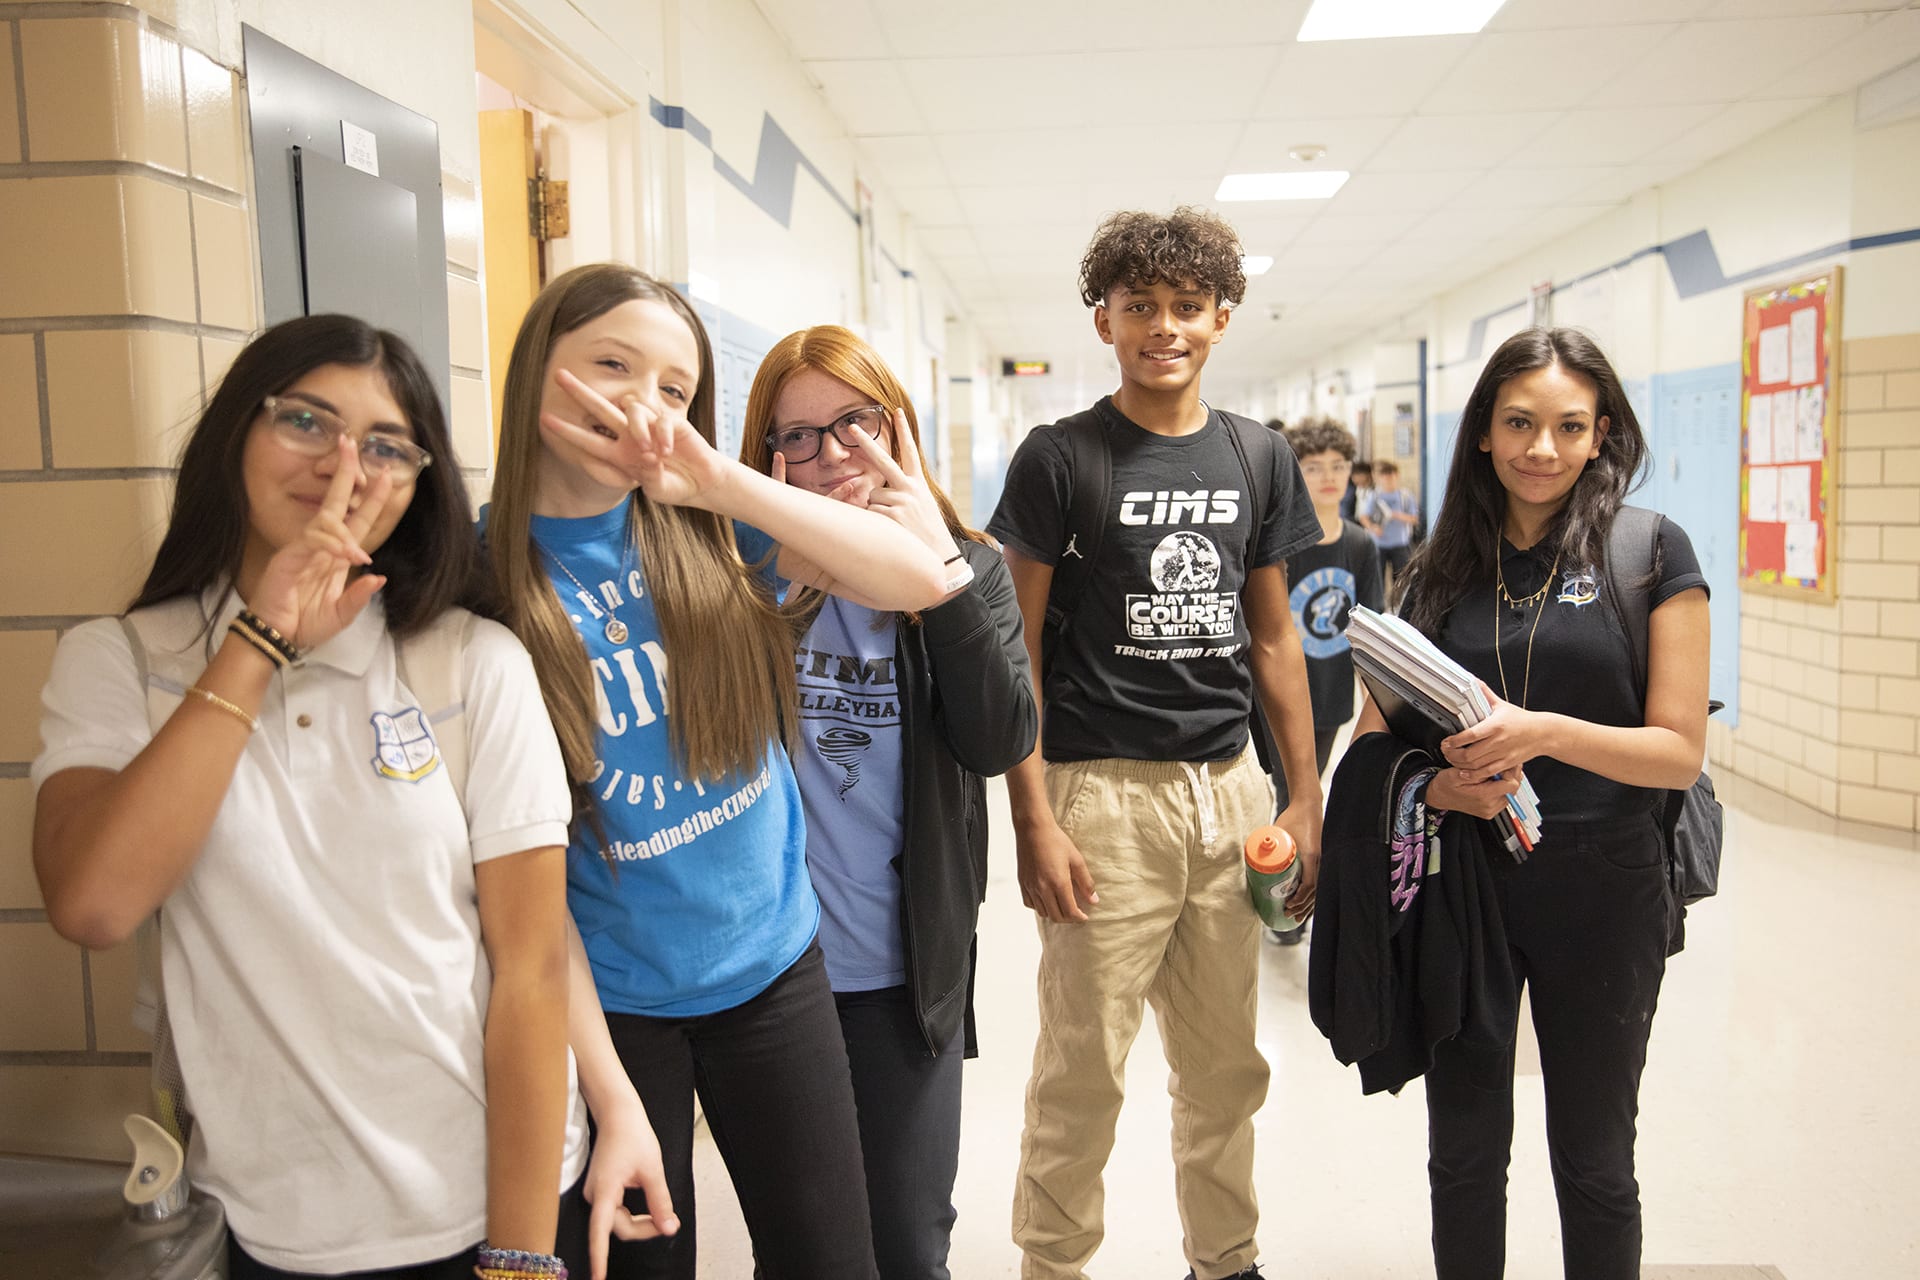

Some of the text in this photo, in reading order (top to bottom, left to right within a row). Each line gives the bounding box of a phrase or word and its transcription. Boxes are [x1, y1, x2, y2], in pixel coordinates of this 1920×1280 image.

[1119, 490, 1240, 526] CIMS
[1150, 592, 1220, 606] MAY THE
[1130, 599, 1233, 624] COURSE
[1130, 621, 1231, 636] BE WITH YOU
